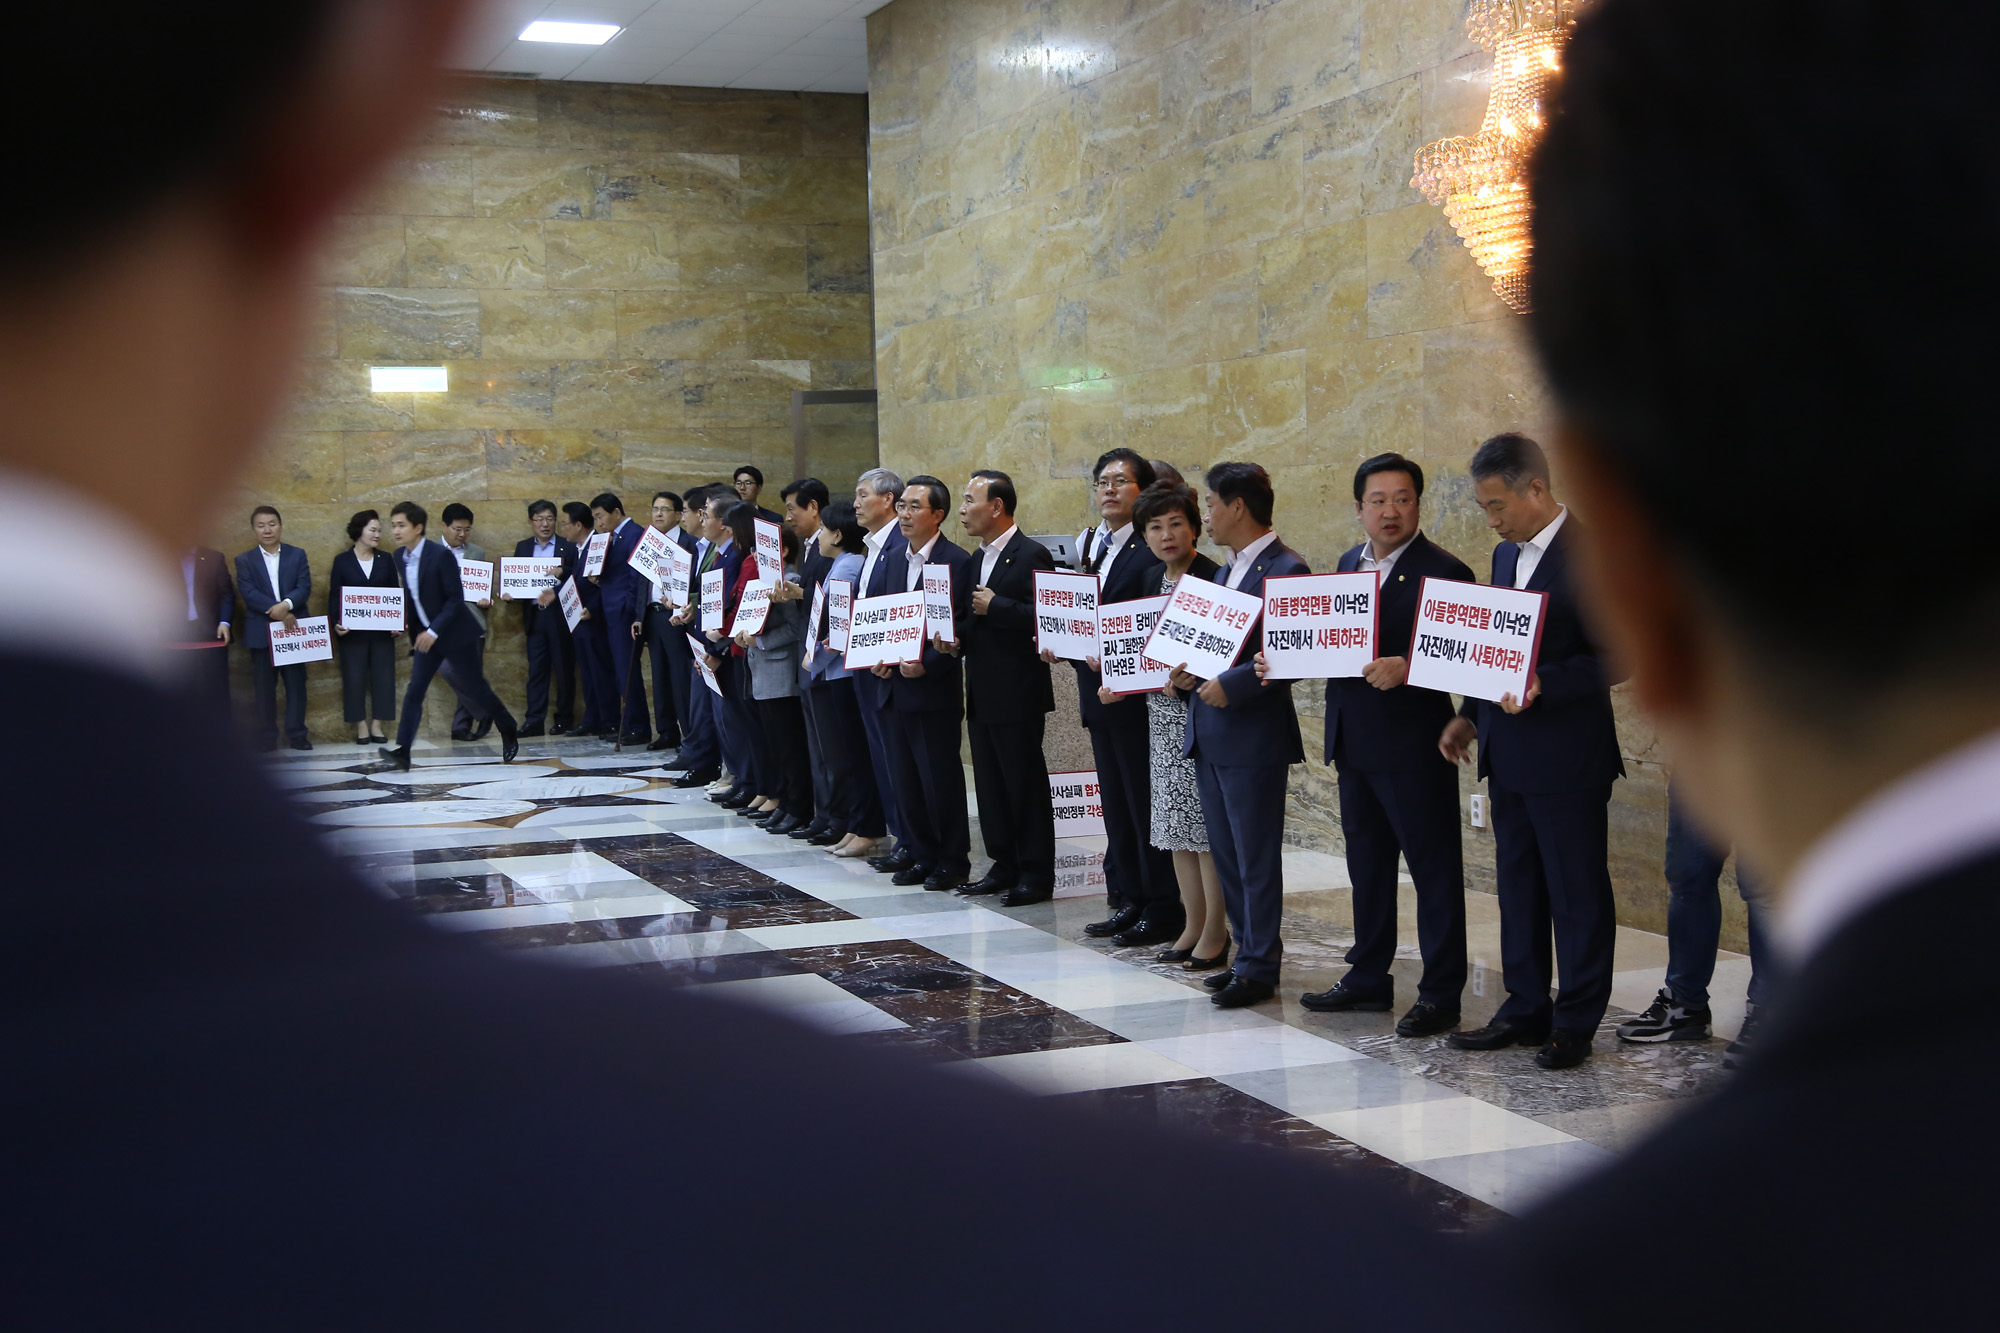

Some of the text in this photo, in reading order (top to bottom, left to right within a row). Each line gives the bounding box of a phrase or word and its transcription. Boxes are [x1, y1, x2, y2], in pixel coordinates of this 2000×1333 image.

[463, 566, 490, 579] 협치포기
[503, 564, 530, 574] 위장전입
[462, 580, 489, 592] 각성하라!
[503, 578, 529, 588] 문재인은
[344, 594, 402, 606] 아들병역면탈 이낙연
[1038, 588, 1095, 611] 아들병역면탈 이낙연
[1173, 590, 1251, 631] 위장전입 이낙연
[1268, 592, 1369, 618] 아들병역면탈 이낙연
[344, 608, 401, 619] 자진해서 사퇴하라!
[854, 603, 924, 627] 인사실패 협치포기
[1101, 610, 1164, 635] 5천만원 당비대
[1423, 598, 1532, 637] 아들병역면탈 이낙연
[308, 624, 327, 635] 이낙연
[850, 626, 921, 649] 문재인정부 각성하라!
[1038, 615, 1096, 639] 자진해서 사퇴하라!
[1158, 618, 1236, 659] 문재인은 철회하라!
[274, 639, 328, 654] 자진해서 사퇴하라!
[1103, 639, 1118, 657] 교사
[1267, 627, 1368, 651] 자진해서 사퇴하라!
[1417, 633, 1525, 674] 자진해서 사퇴하라!
[1104, 655, 1174, 678] 이낙연은 사퇴
[1086, 804, 1105, 818] 각성
